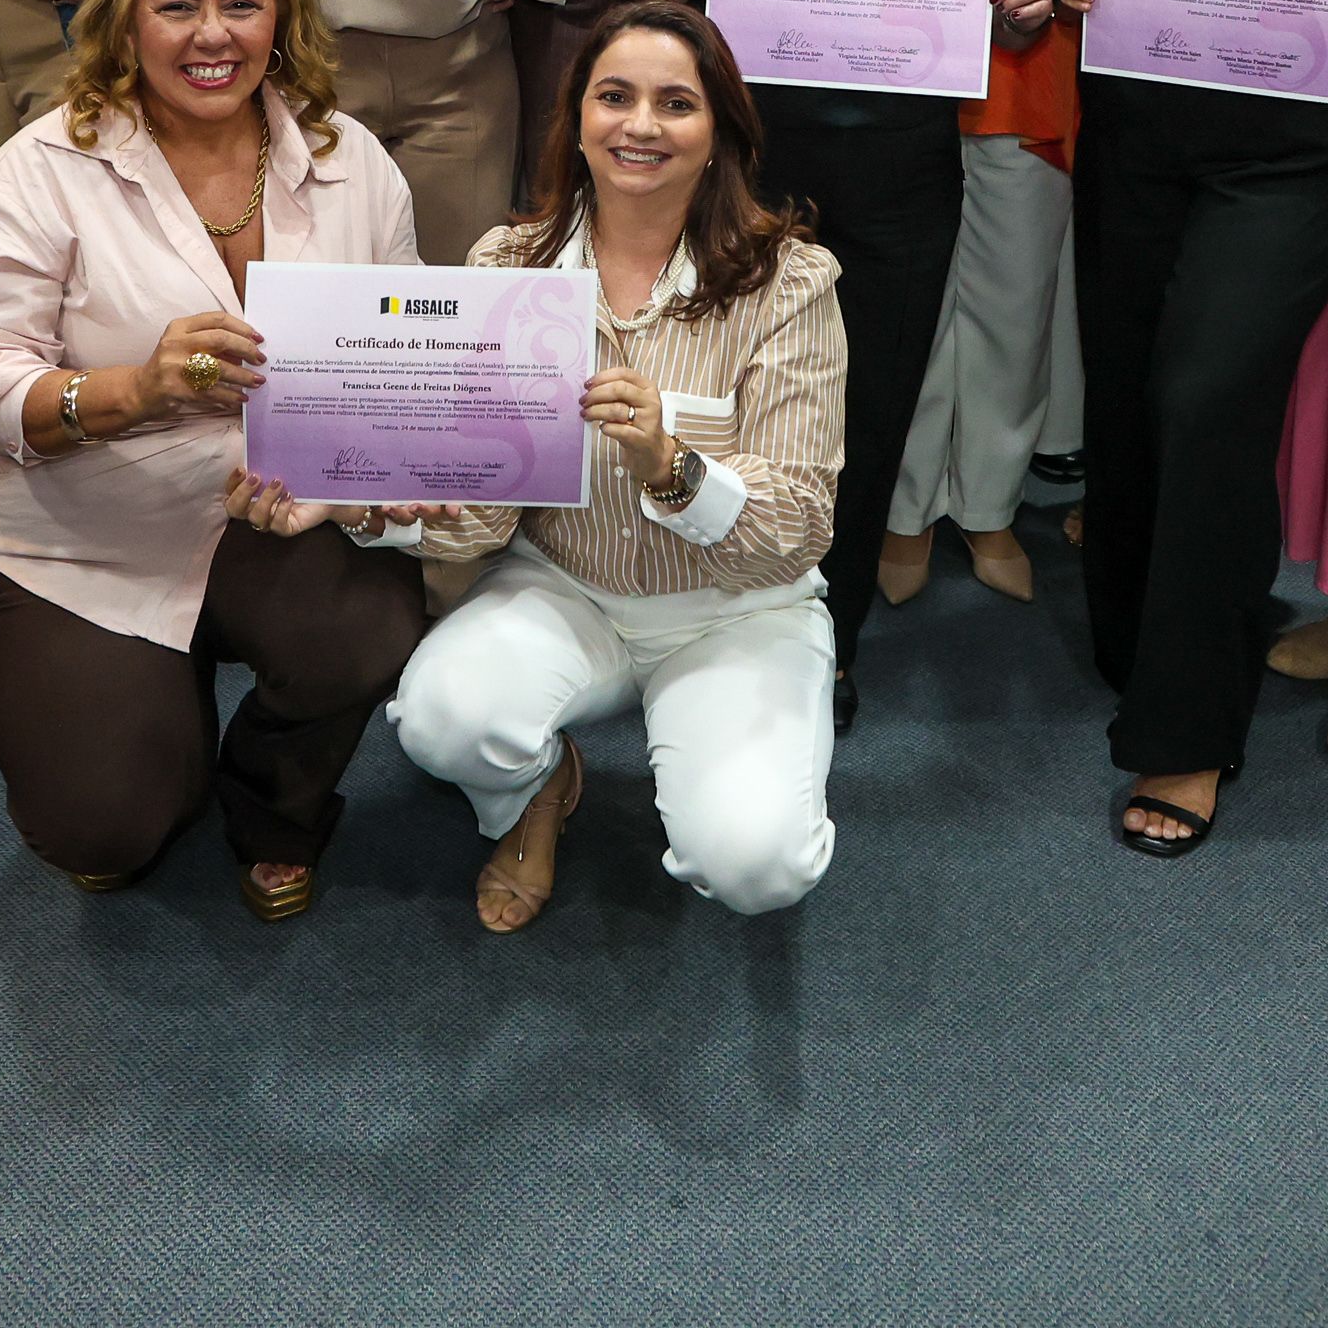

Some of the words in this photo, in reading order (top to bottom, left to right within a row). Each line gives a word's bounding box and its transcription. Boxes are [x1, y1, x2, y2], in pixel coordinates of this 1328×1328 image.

[404, 299, 459, 316] ASSALCE
[335, 337, 404, 349] Certificado
[407, 338, 422, 350] de
[425, 339, 501, 354] Homenagem
[342, 381, 381, 390] Francisca
[383, 382, 409, 390] Geene
[411, 382, 421, 391] de
[423, 383, 451, 391] Freitas
[453, 383, 492, 394] Diógenes
